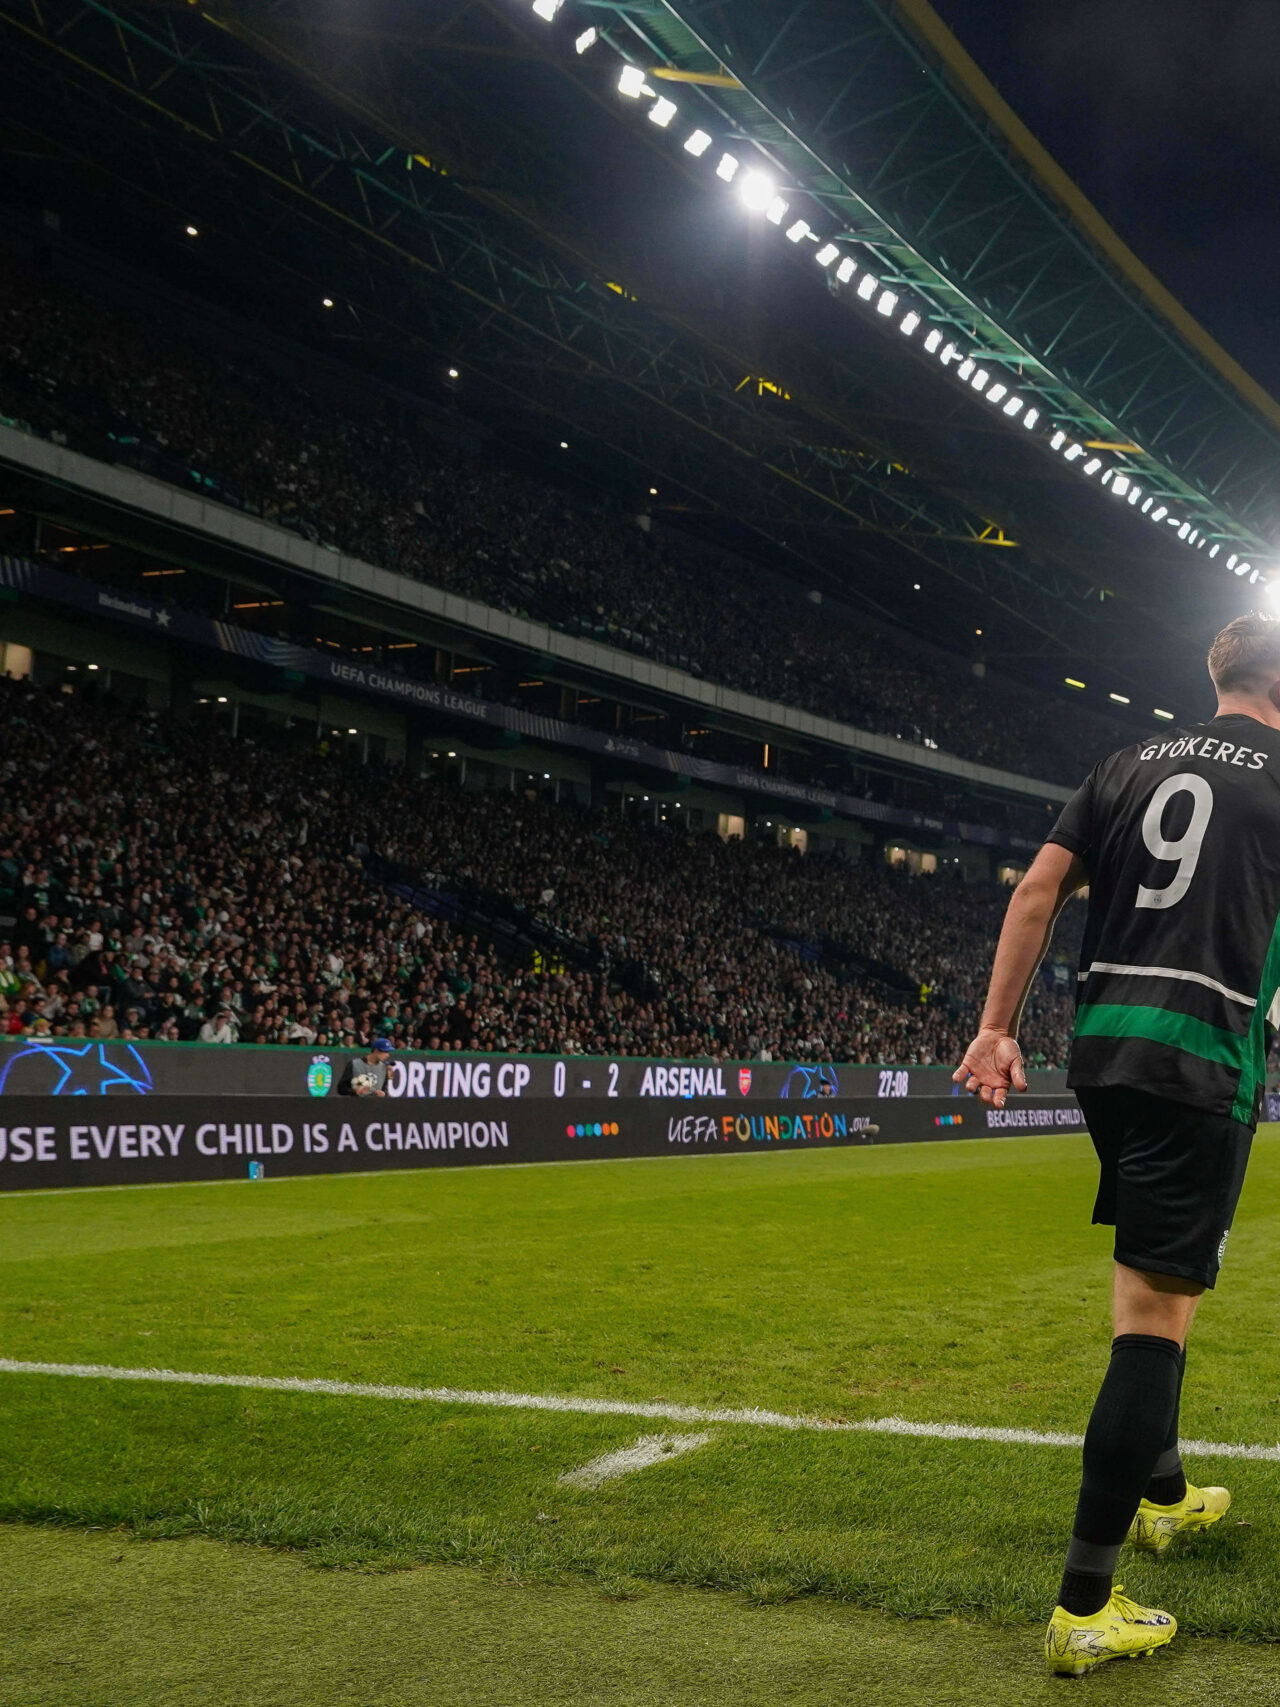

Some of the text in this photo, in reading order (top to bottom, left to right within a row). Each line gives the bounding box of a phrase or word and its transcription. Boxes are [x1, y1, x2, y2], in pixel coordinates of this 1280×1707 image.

[330, 661, 488, 719] UEFA CHAMPIONS LEAGUE
[1140, 736, 1269, 770] GYÖKERES
[1135, 772, 1214, 910] 9
[387, 1060, 491, 1098] ORTING
[497, 1062, 531, 1097] CP
[553, 1061, 566, 1097] 0
[607, 1062, 619, 1097] 2
[639, 1065, 727, 1098] ARSENAL
[877, 1069, 909, 1098] 27:08
[668, 1115, 718, 1143] UEFA
[986, 1109, 1028, 1129] BECAUSE
[1028, 1108, 1054, 1127] EVERY
[1055, 1108, 1081, 1125] CHILD
[69, 1123, 186, 1161] EVERY
[195, 1123, 294, 1155] CHILD
[302, 1122, 330, 1153] IS
[337, 1122, 359, 1153] A
[364, 1120, 510, 1151] CHAMPION
